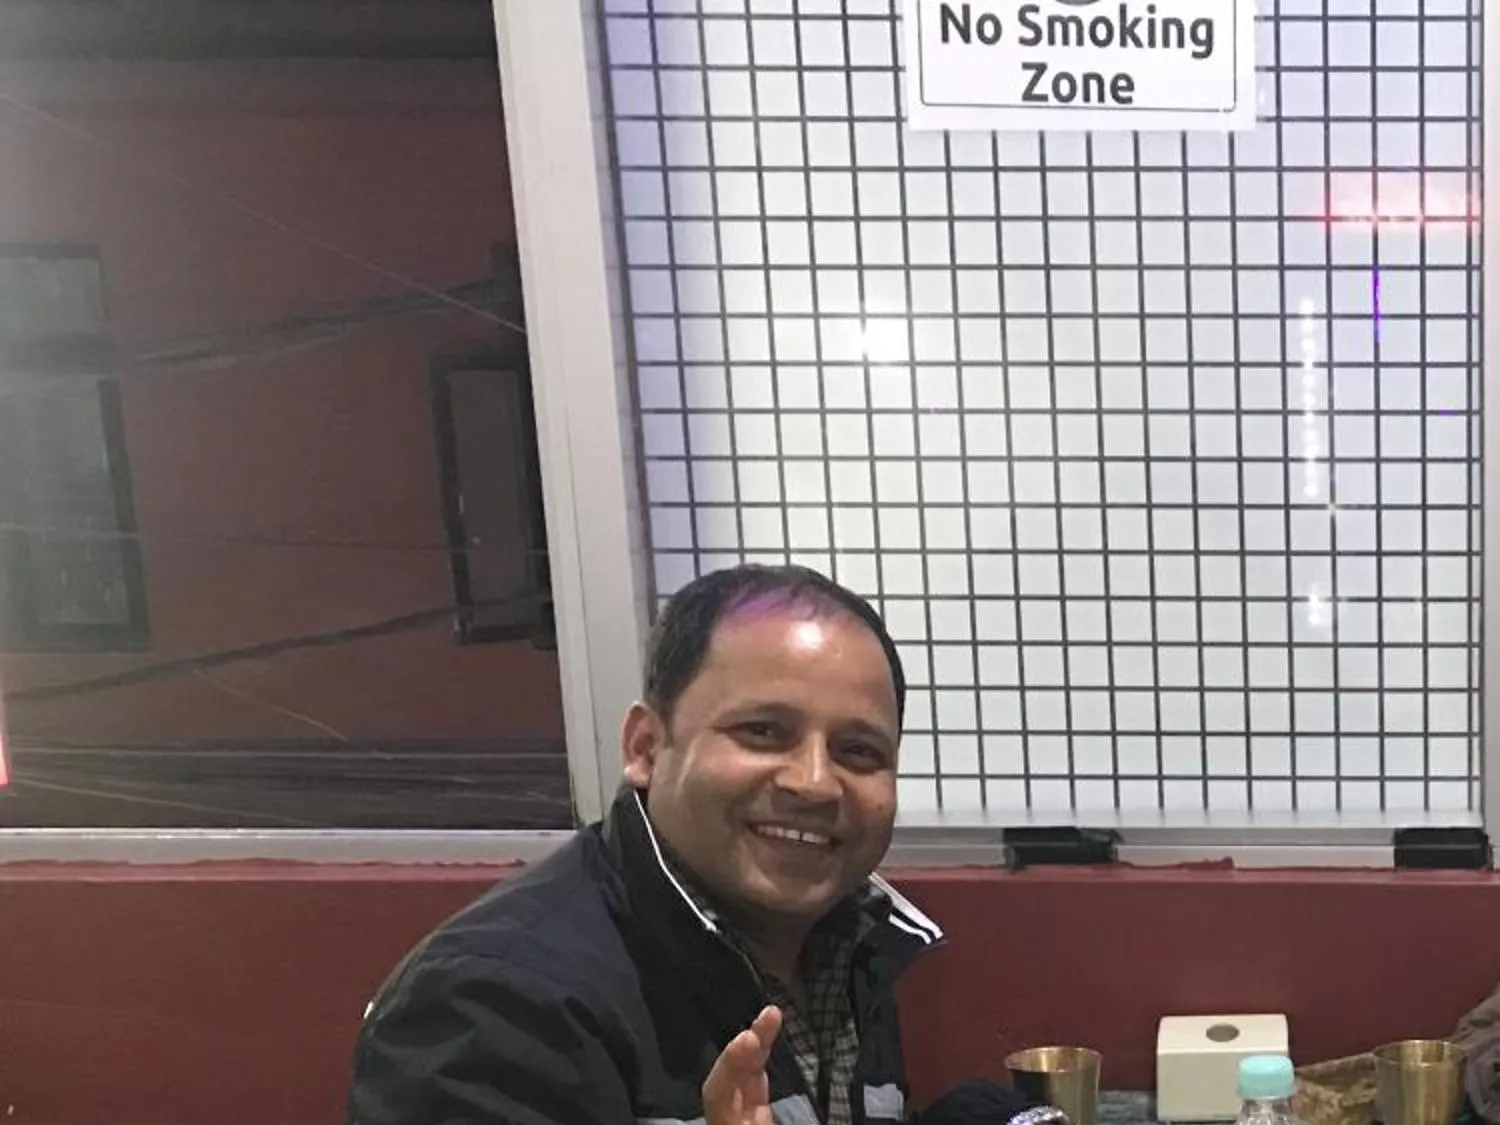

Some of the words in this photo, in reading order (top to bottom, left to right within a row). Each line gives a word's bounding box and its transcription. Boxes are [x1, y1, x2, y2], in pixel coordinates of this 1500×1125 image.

[940, 3, 1002, 45] No
[1017, 3, 1214, 60] Smoking
[1021, 62, 1135, 105] Zone
